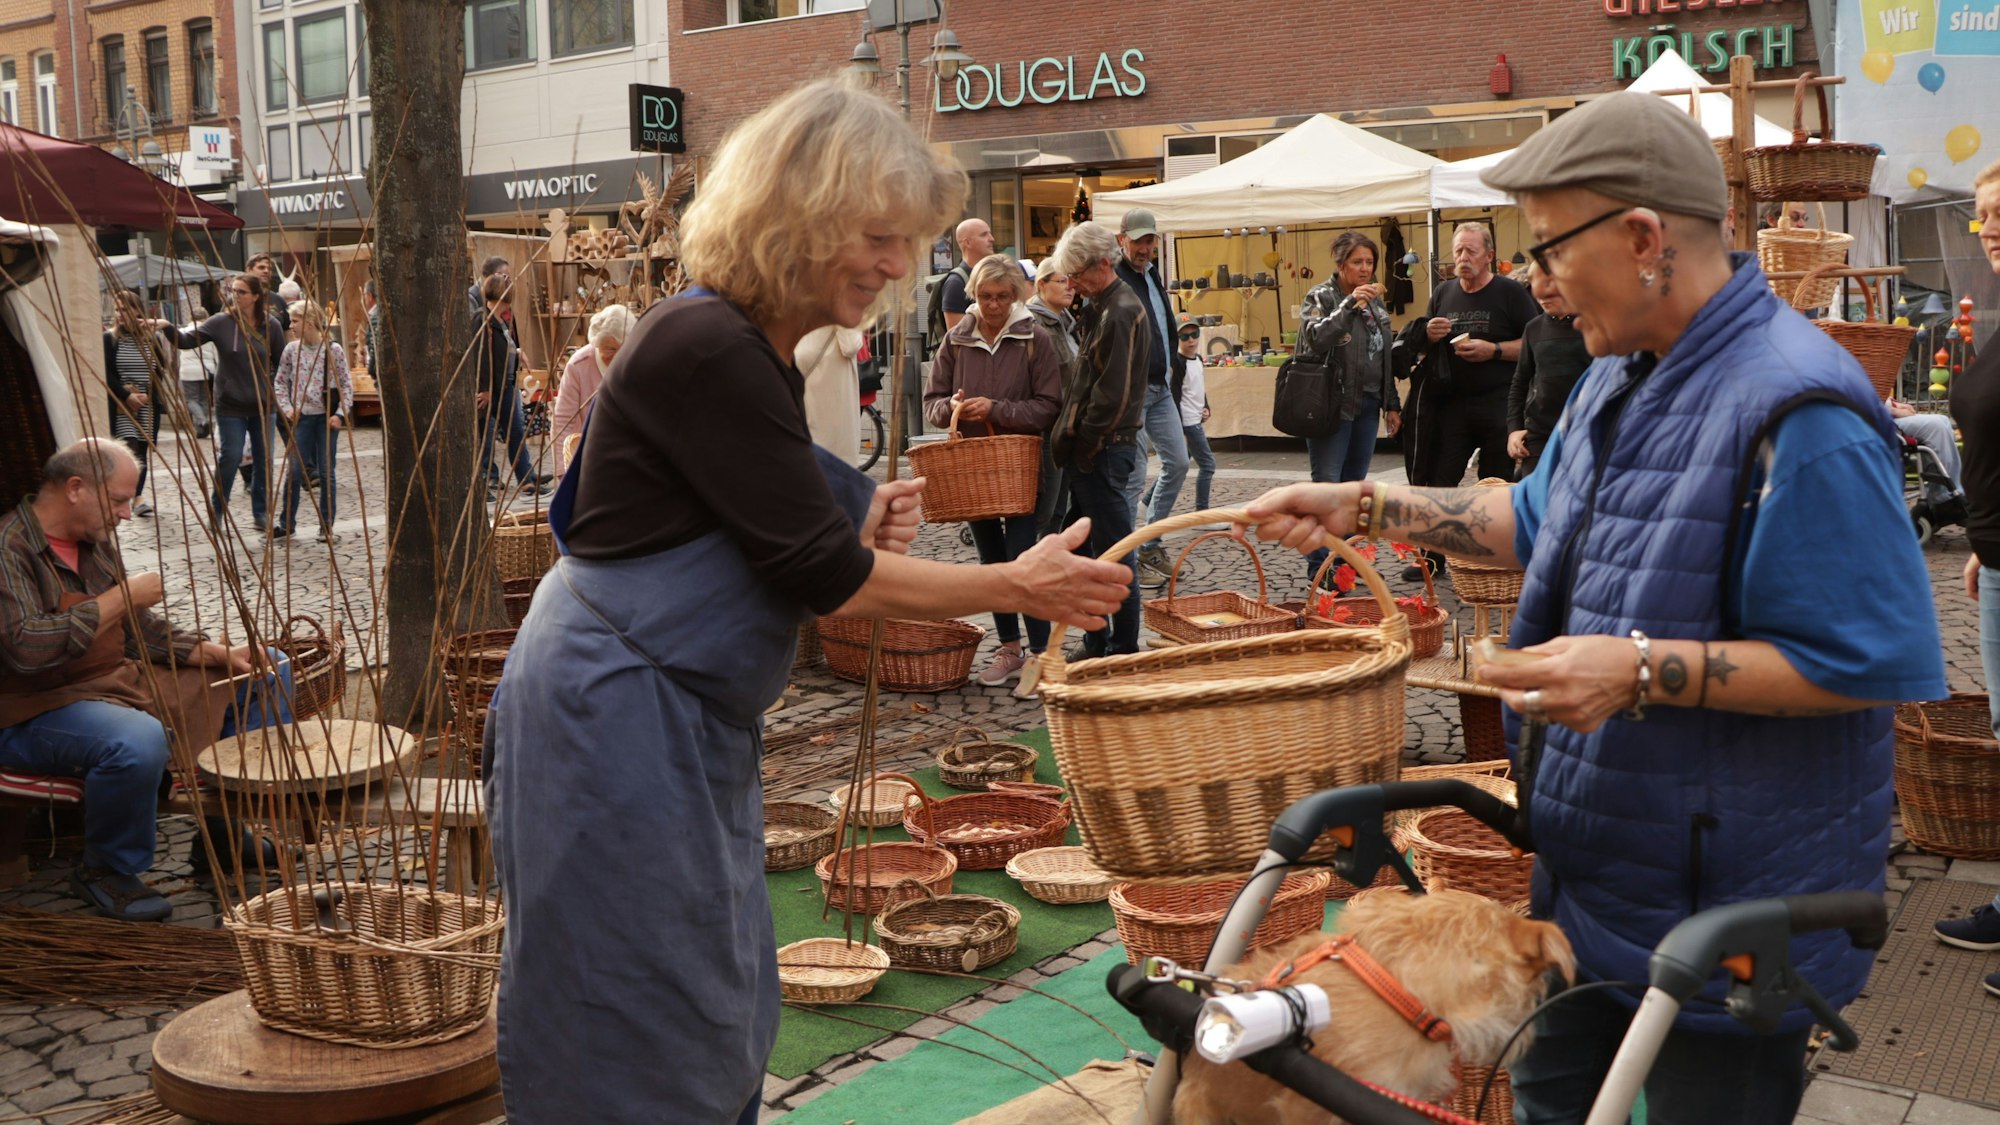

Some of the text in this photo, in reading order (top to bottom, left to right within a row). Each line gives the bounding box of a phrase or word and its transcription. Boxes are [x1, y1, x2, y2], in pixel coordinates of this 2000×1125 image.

[1880, 4, 2000, 35] Wir sind
[934, 48, 1146, 112] DOUGLAS
[643, 130, 678, 143] DOUGLAS
[504, 174, 598, 200] VIVAOPTIC
